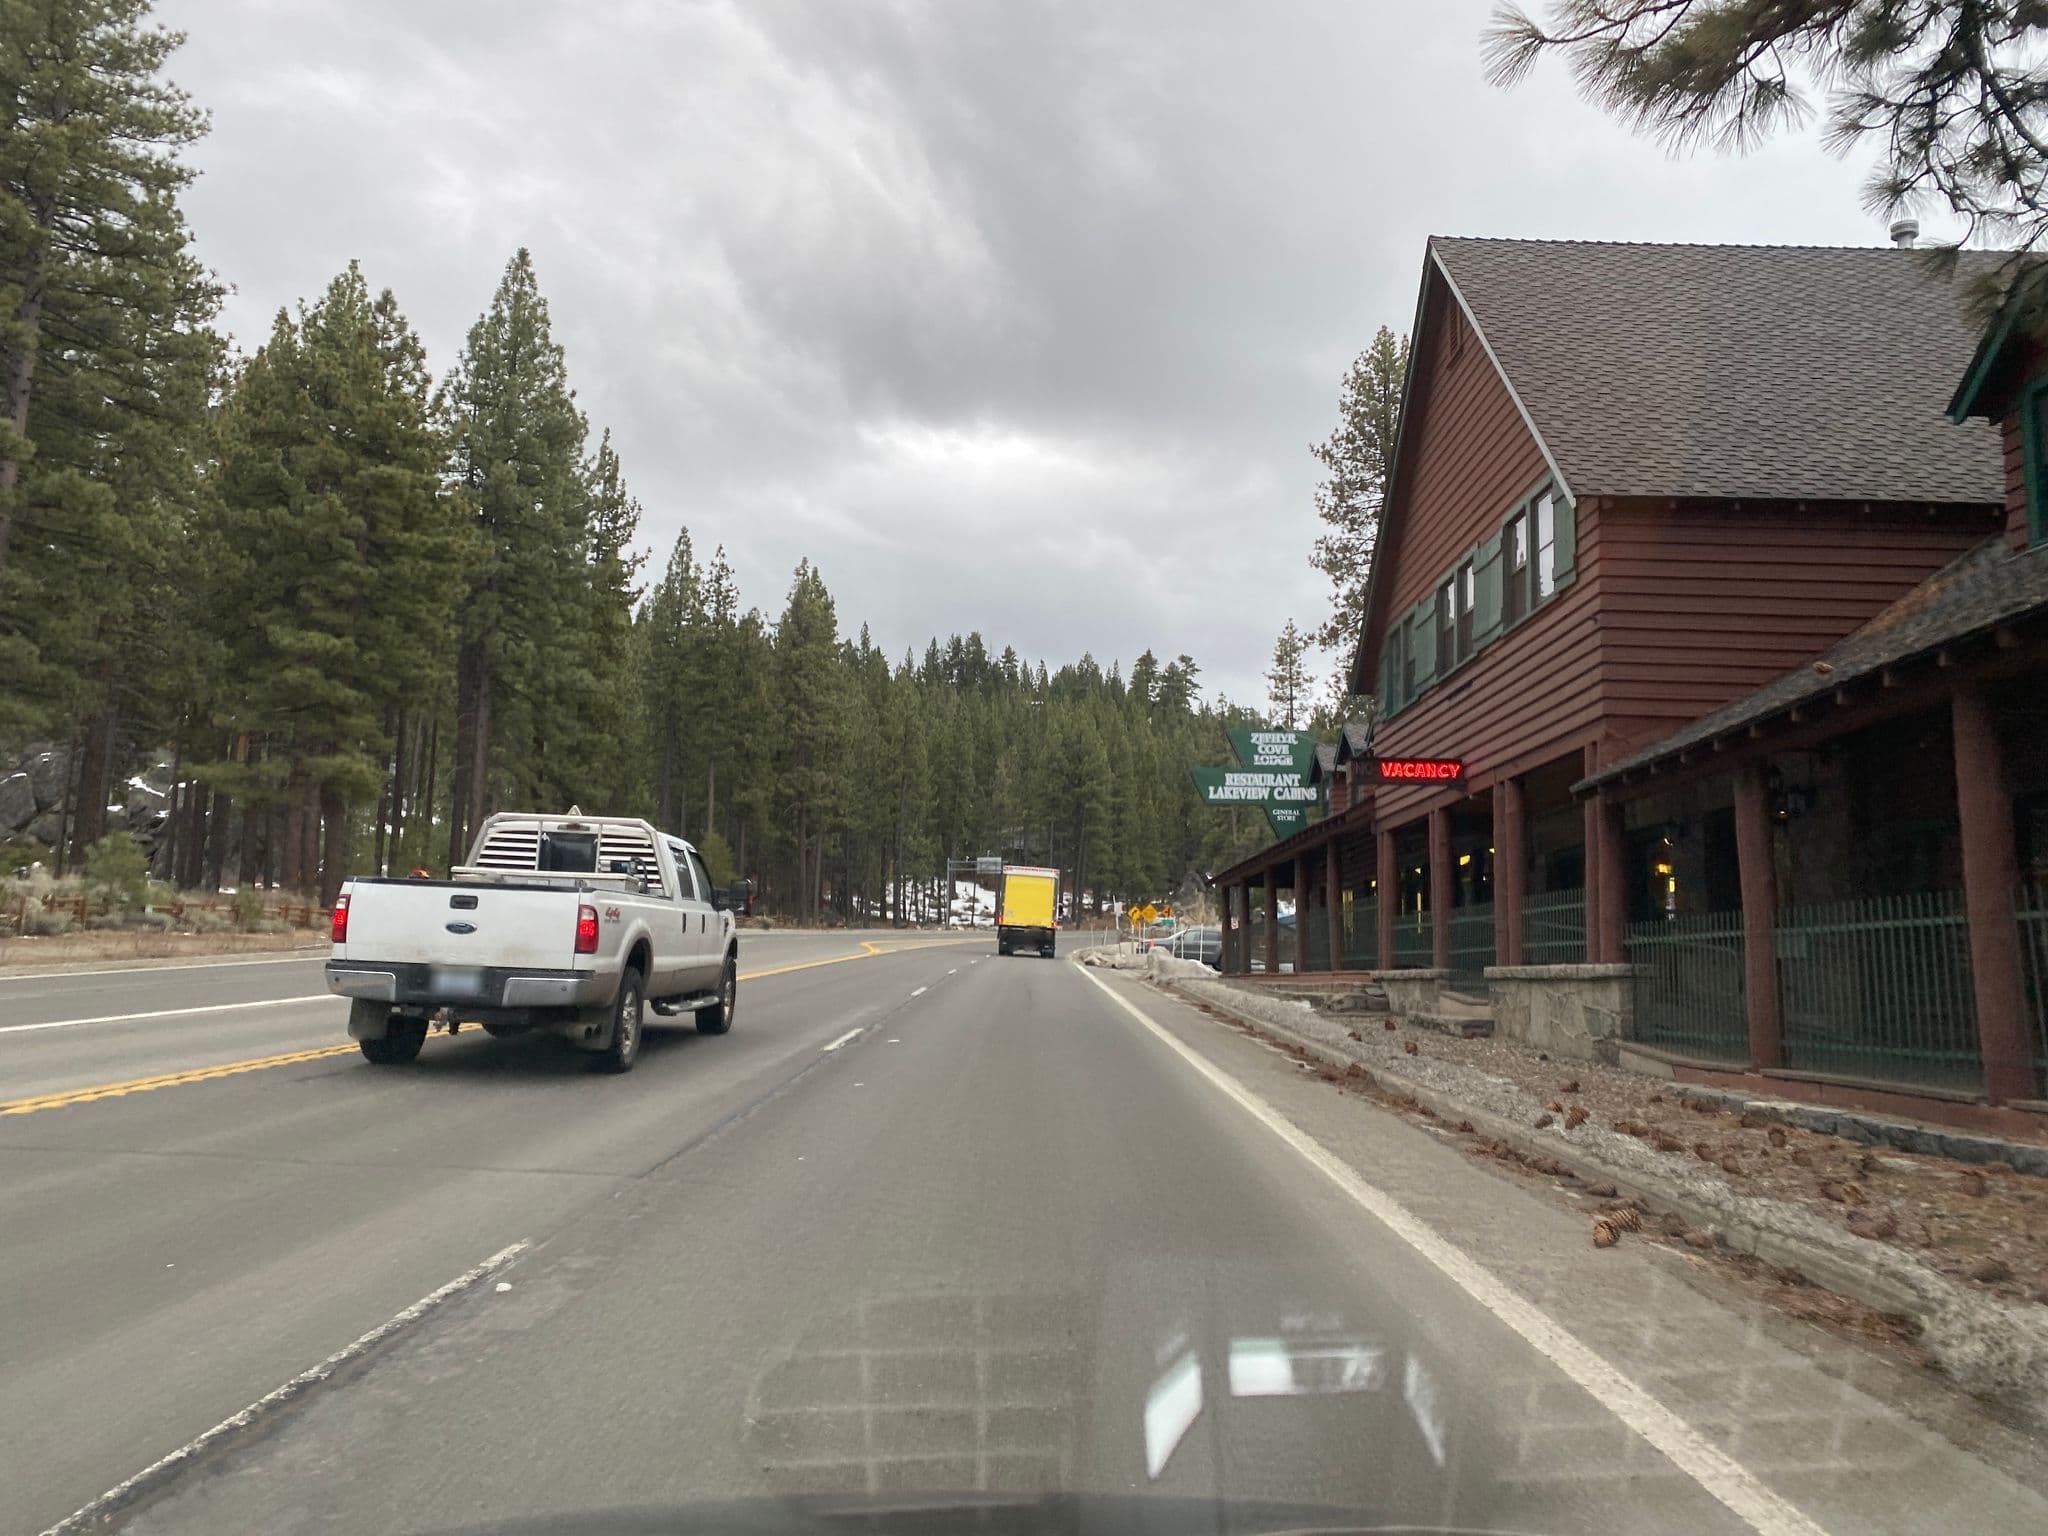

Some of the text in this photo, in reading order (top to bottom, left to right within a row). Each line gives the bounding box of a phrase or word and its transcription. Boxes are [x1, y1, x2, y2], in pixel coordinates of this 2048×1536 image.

[1250, 732, 1298, 744] ZEPHYR
[1257, 744, 1289, 754] COVE
[1253, 755, 1294, 765] LODGE
[1381, 762, 1460, 779] VACANCY
[1225, 773, 1301, 786] RESTAURANT
[1208, 786, 1318, 801] LAKEVIEW CABINS
[1272, 808, 1300, 816] GENERAL
